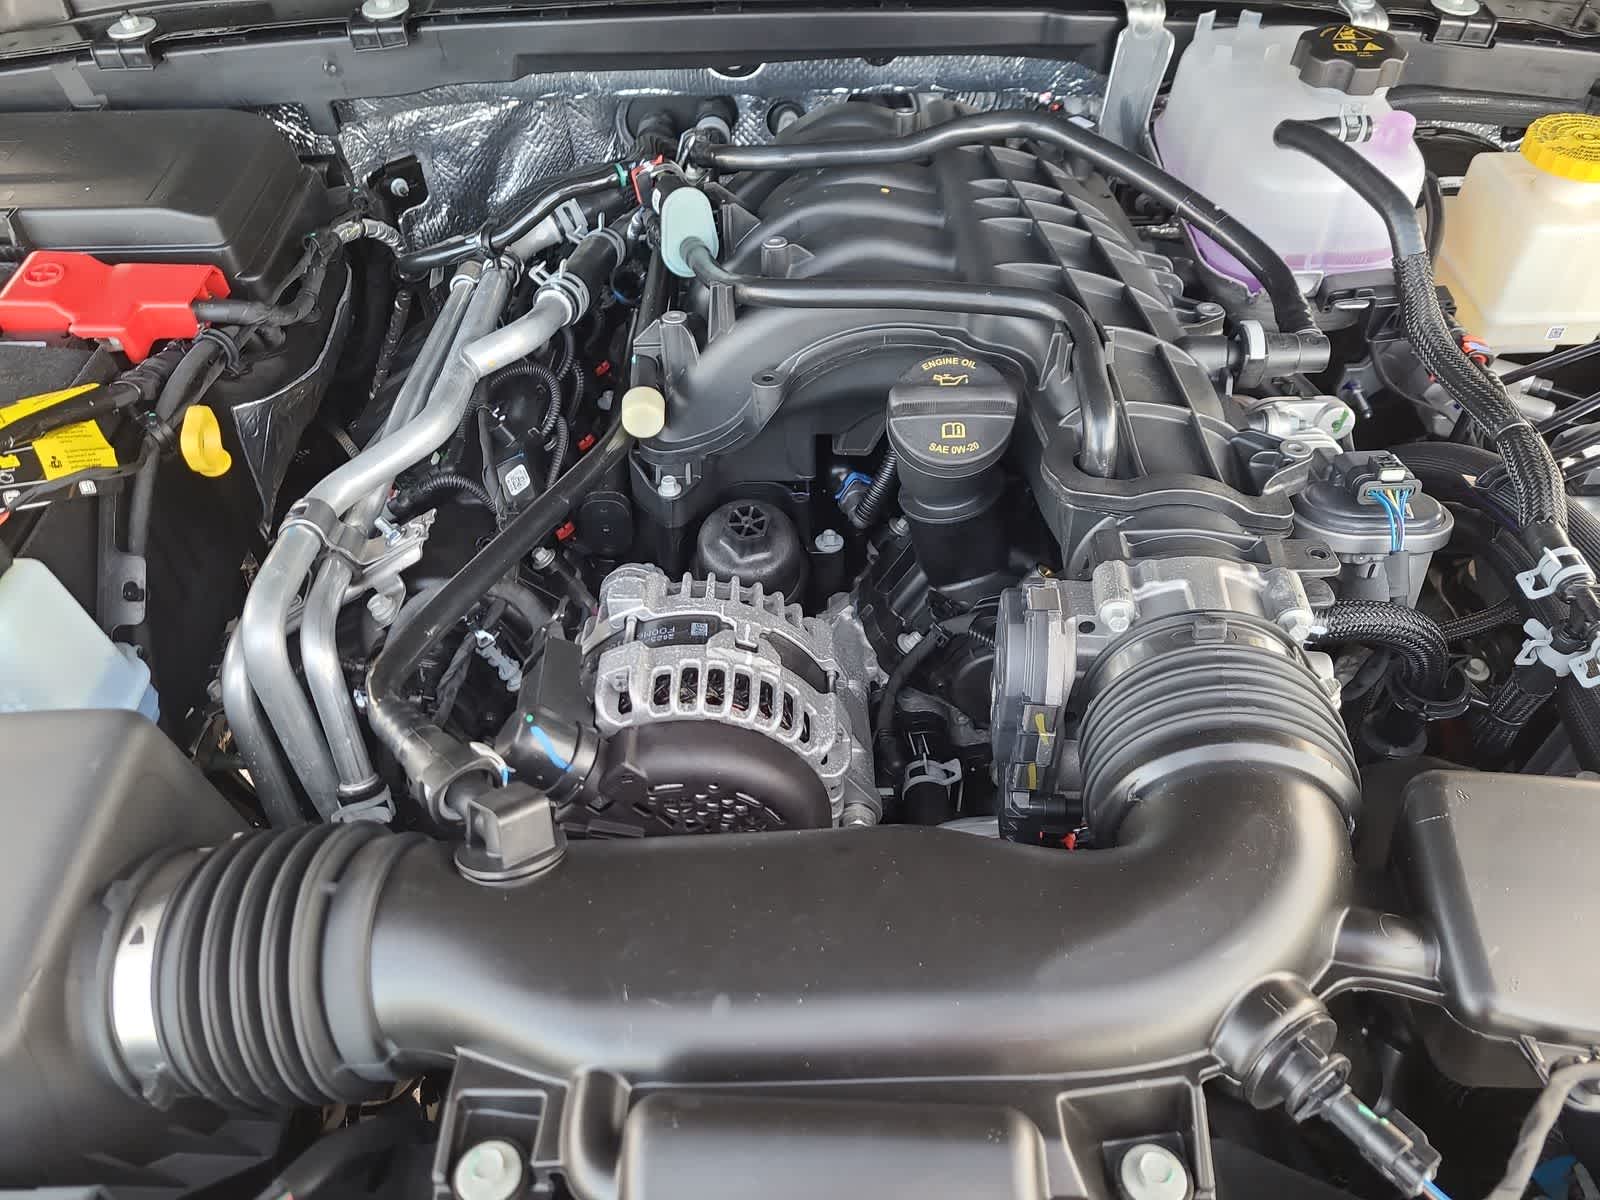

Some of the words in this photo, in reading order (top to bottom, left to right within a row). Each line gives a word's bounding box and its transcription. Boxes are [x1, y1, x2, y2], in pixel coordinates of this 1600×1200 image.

[921, 357, 959, 371] ENGINE
[961, 358, 977, 369] OIL
[928, 442, 949, 454] SAE
[951, 441, 980, 454] 0W-20
